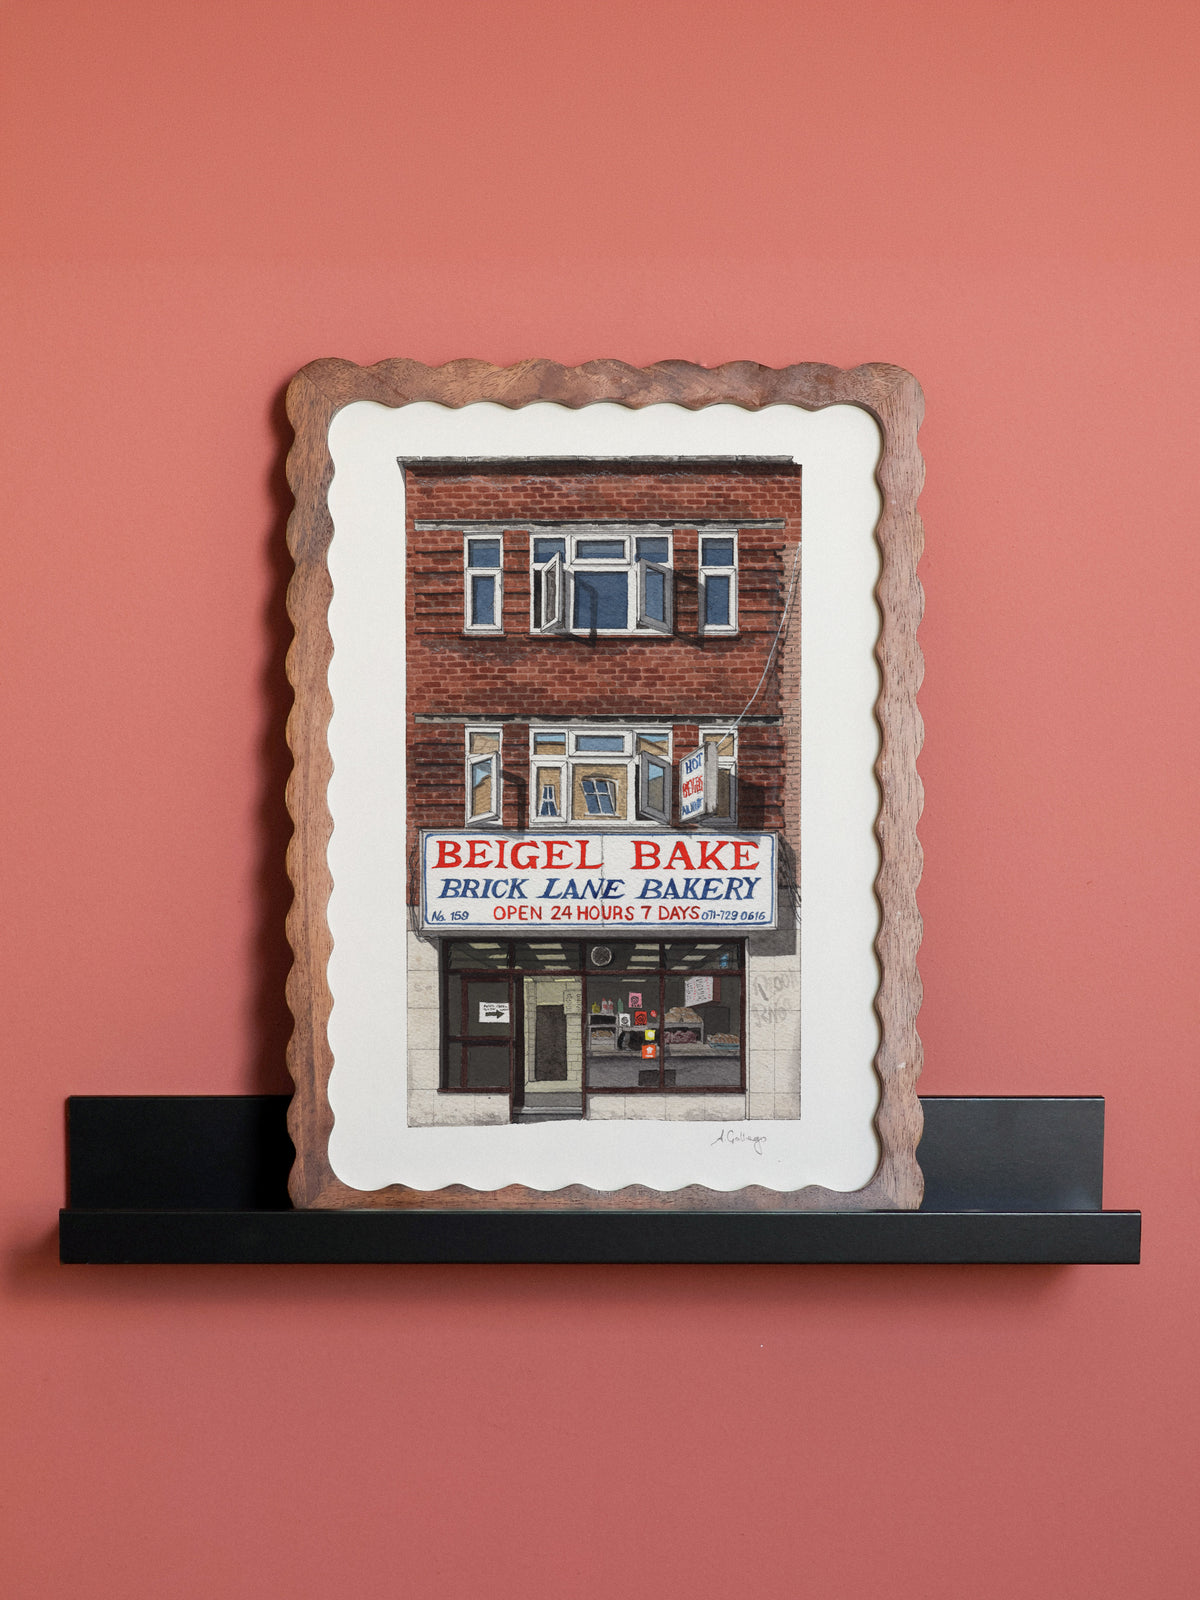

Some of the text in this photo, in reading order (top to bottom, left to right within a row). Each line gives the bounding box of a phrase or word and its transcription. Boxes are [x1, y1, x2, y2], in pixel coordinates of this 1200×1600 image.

[685, 752, 703, 774] HOT
[431, 840, 760, 871] BEIGEL BAKE
[437, 877, 762, 900] BRICK LANE BAKERY
[450, 910, 470, 921] 159
[493, 905, 701, 921] OPEN 24 HOURS 7 DAYS
[740, 911, 766, 921] 0616
